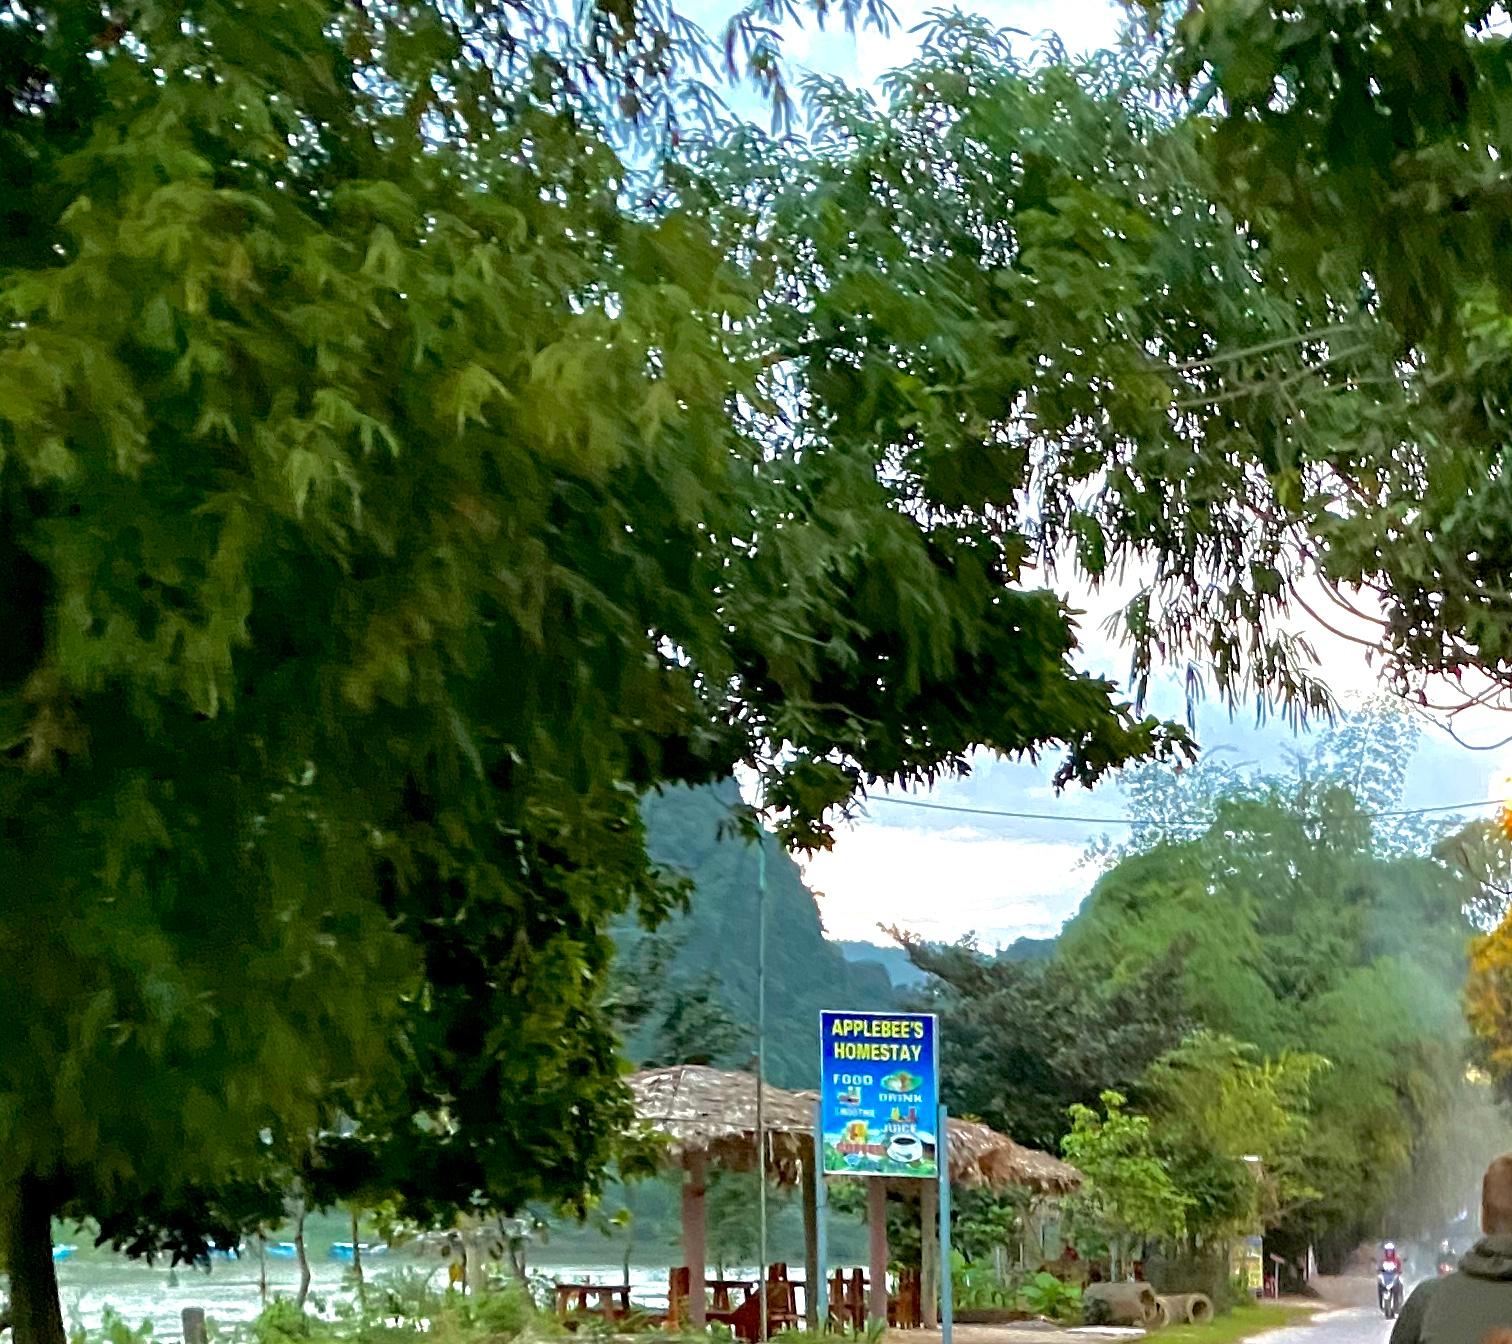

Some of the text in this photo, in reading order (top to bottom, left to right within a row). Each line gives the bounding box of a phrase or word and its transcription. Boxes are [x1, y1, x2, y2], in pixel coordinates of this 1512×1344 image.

[832, 1019, 924, 1039] APPLEBEE'S
[834, 1042, 922, 1062] HOMESTAY
[833, 1073, 874, 1086] FOOD
[879, 1093, 923, 1103] DRINK
